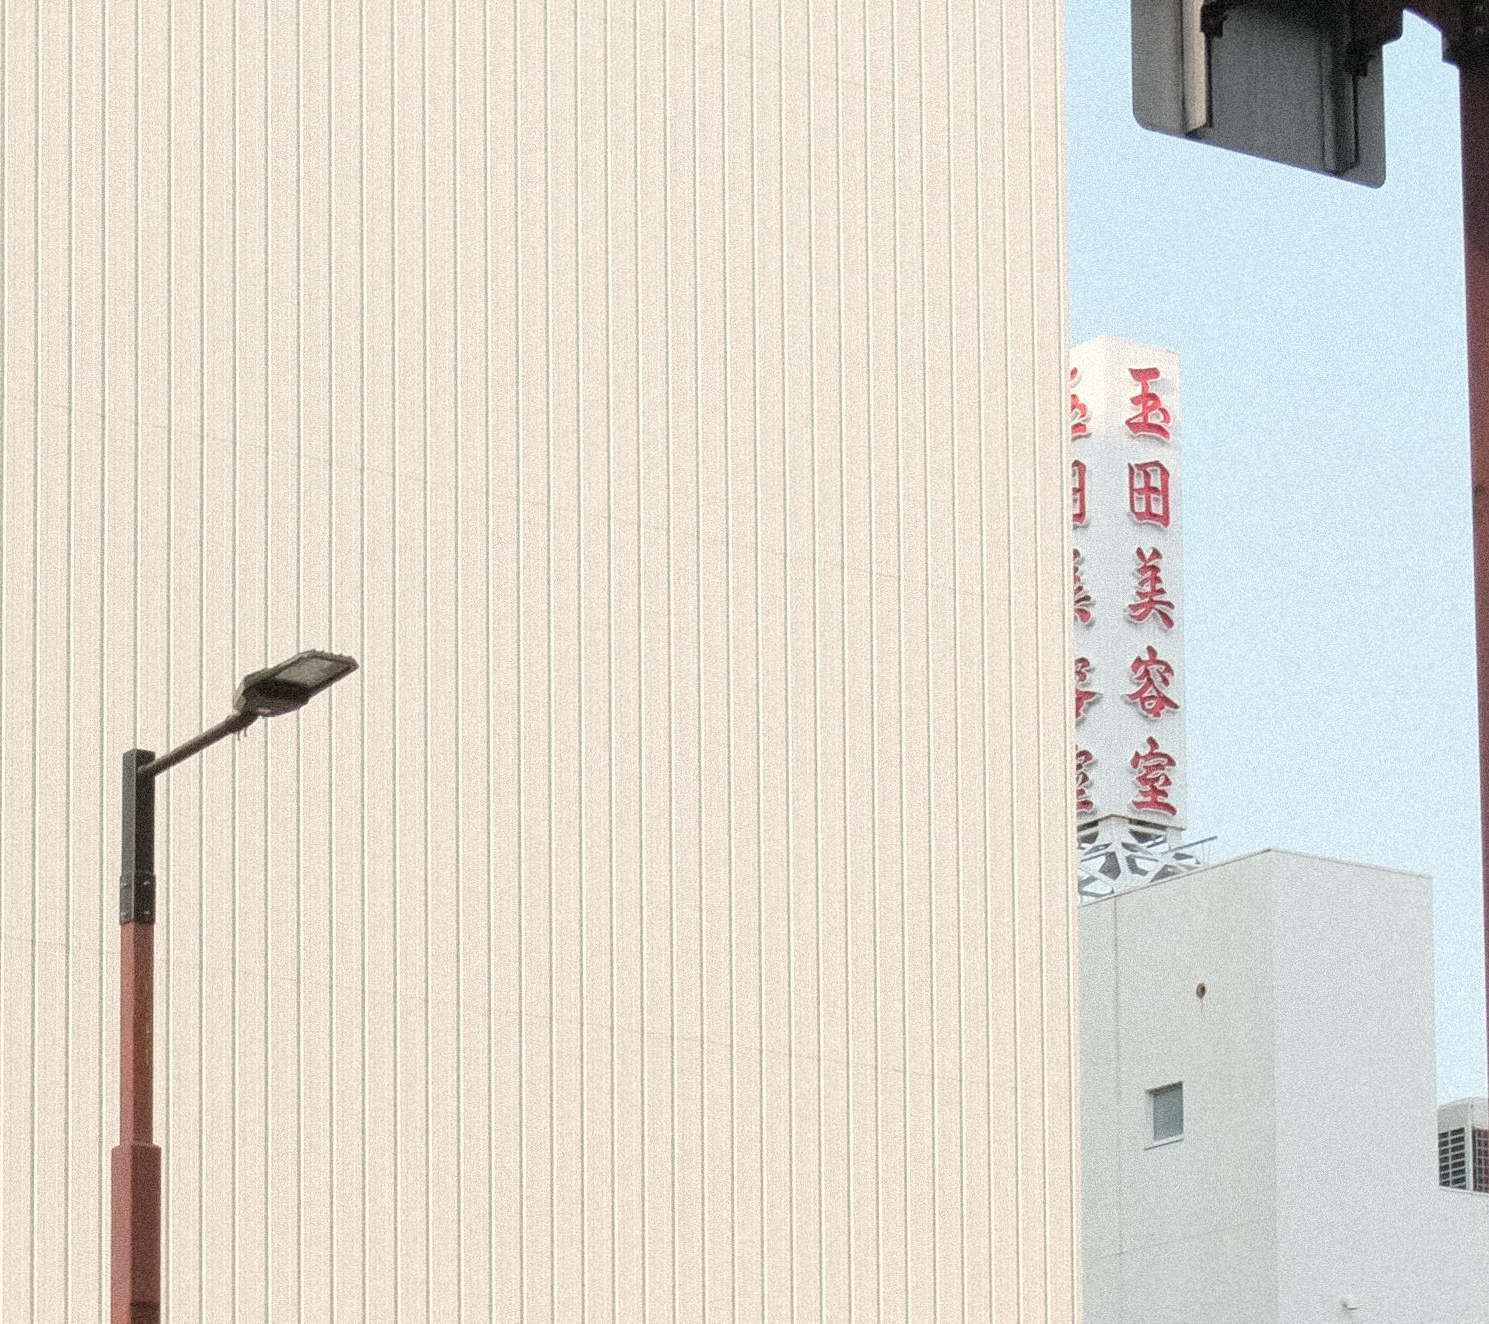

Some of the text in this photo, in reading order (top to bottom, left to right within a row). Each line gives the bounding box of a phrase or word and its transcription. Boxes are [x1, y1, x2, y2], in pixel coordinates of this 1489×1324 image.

[1125, 367, 1180, 816] 玉田美容室
